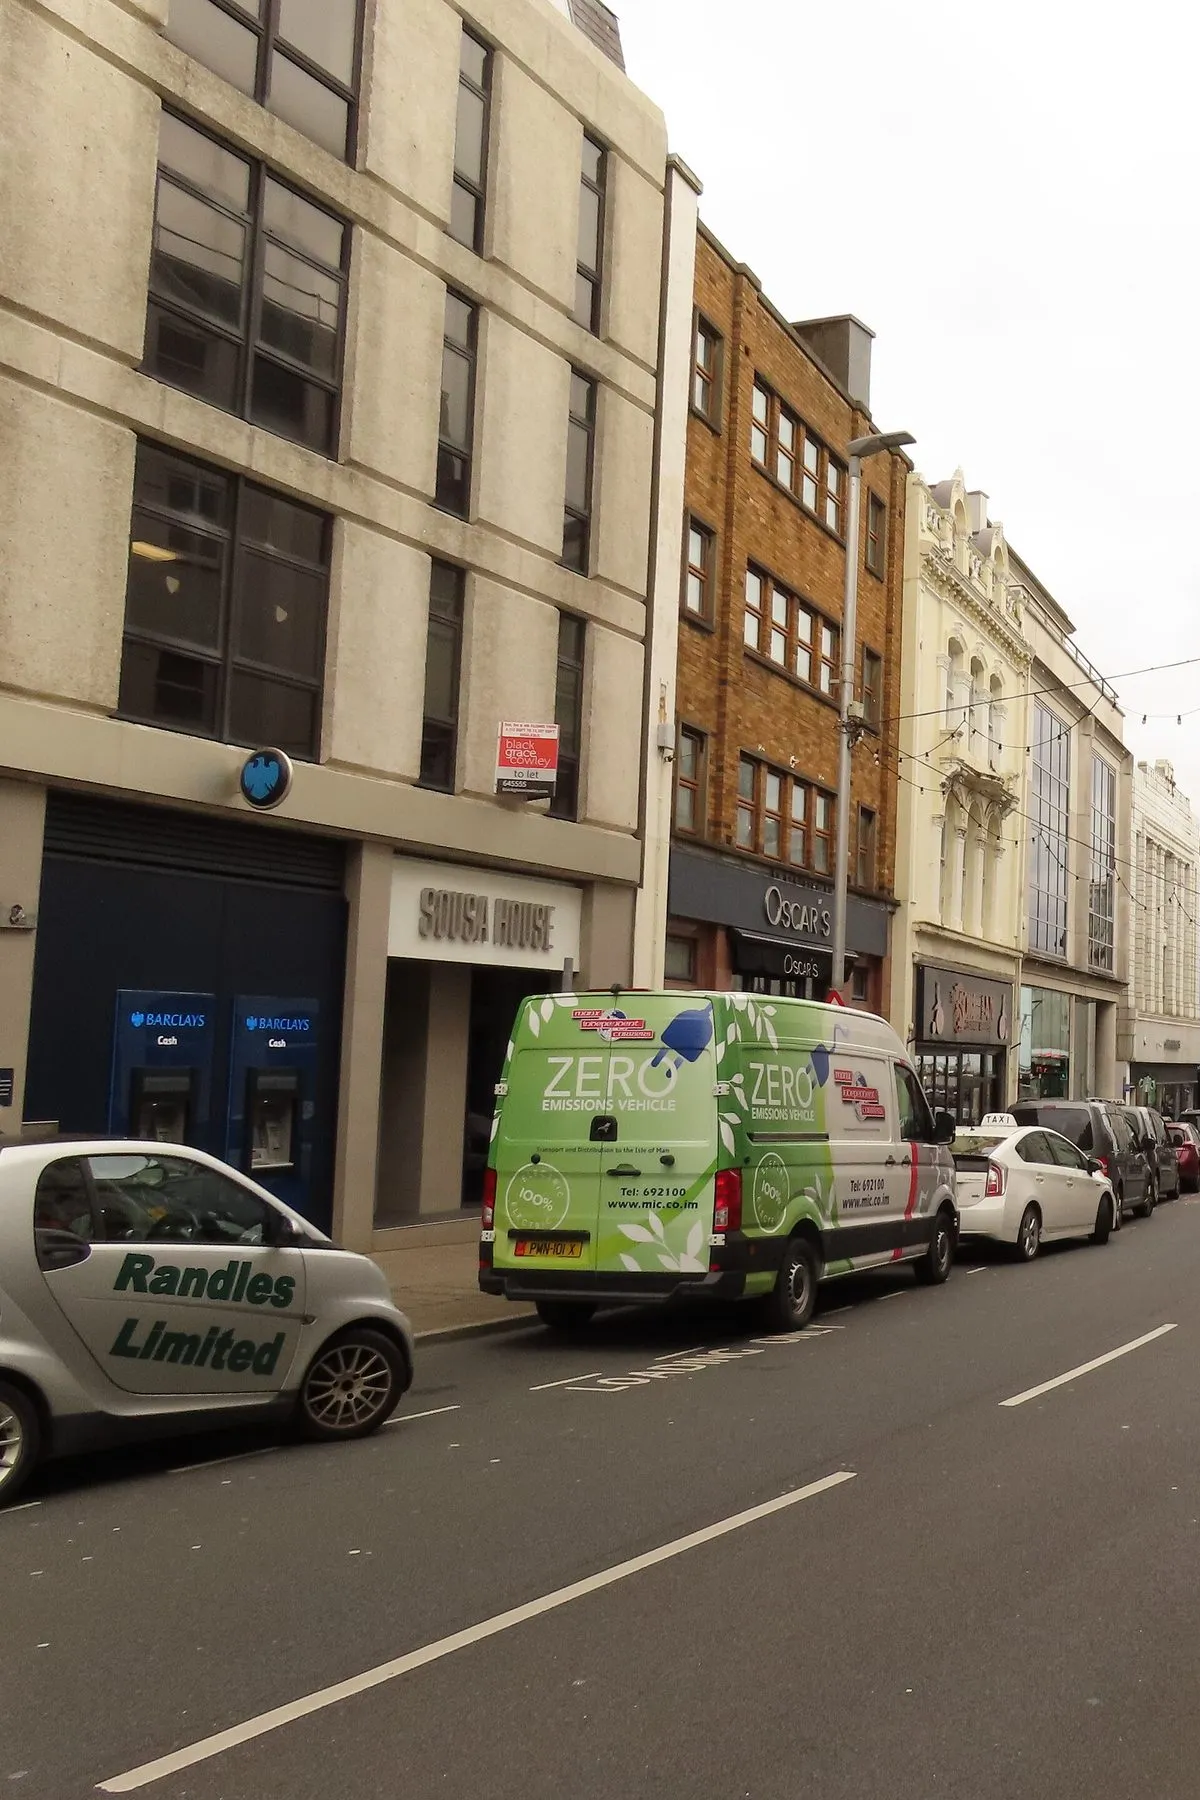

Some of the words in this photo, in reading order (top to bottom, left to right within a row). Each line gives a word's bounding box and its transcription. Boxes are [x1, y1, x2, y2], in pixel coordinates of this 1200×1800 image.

[506, 740, 534, 750] black
[505, 749, 536, 759] grace
[510, 756, 551, 768] cowley
[514, 770, 524, 778] to
[527, 770, 538, 779] let
[419, 887, 489, 943] SOUSA
[493, 898, 556, 951] HOUSE
[146, 1013, 205, 1027] BARCLAYS
[258, 1018, 310, 1030] BARCLAYS
[157, 1035, 178, 1046] Cash
[268, 1038, 286, 1048] Cash
[544, 1056, 678, 1098] ZERO
[750, 1062, 813, 1108] ZERO
[542, 1099, 614, 1111] EMISSIONS
[618, 1099, 676, 1111] VEHICLE
[752, 1108, 788, 1120] EMISSIONS
[789, 1109, 815, 1121] VEHICLE
[986, 1115, 1010, 1124] TAXI
[850, 1180, 861, 1193] Tel:
[862, 1178, 885, 1191] 692100
[621, 1187, 639, 1197] Tel:
[643, 1187, 686, 1197] 692100
[519, 1187, 553, 1212] 100%
[608, 1200, 698, 1210] www.mic.co.im
[842, 1194, 890, 1209] www.mic.co.im
[113, 1252, 296, 1308] Randles
[109, 1318, 287, 1376] Limited
[565, 1347, 765, 1392] LOADING
